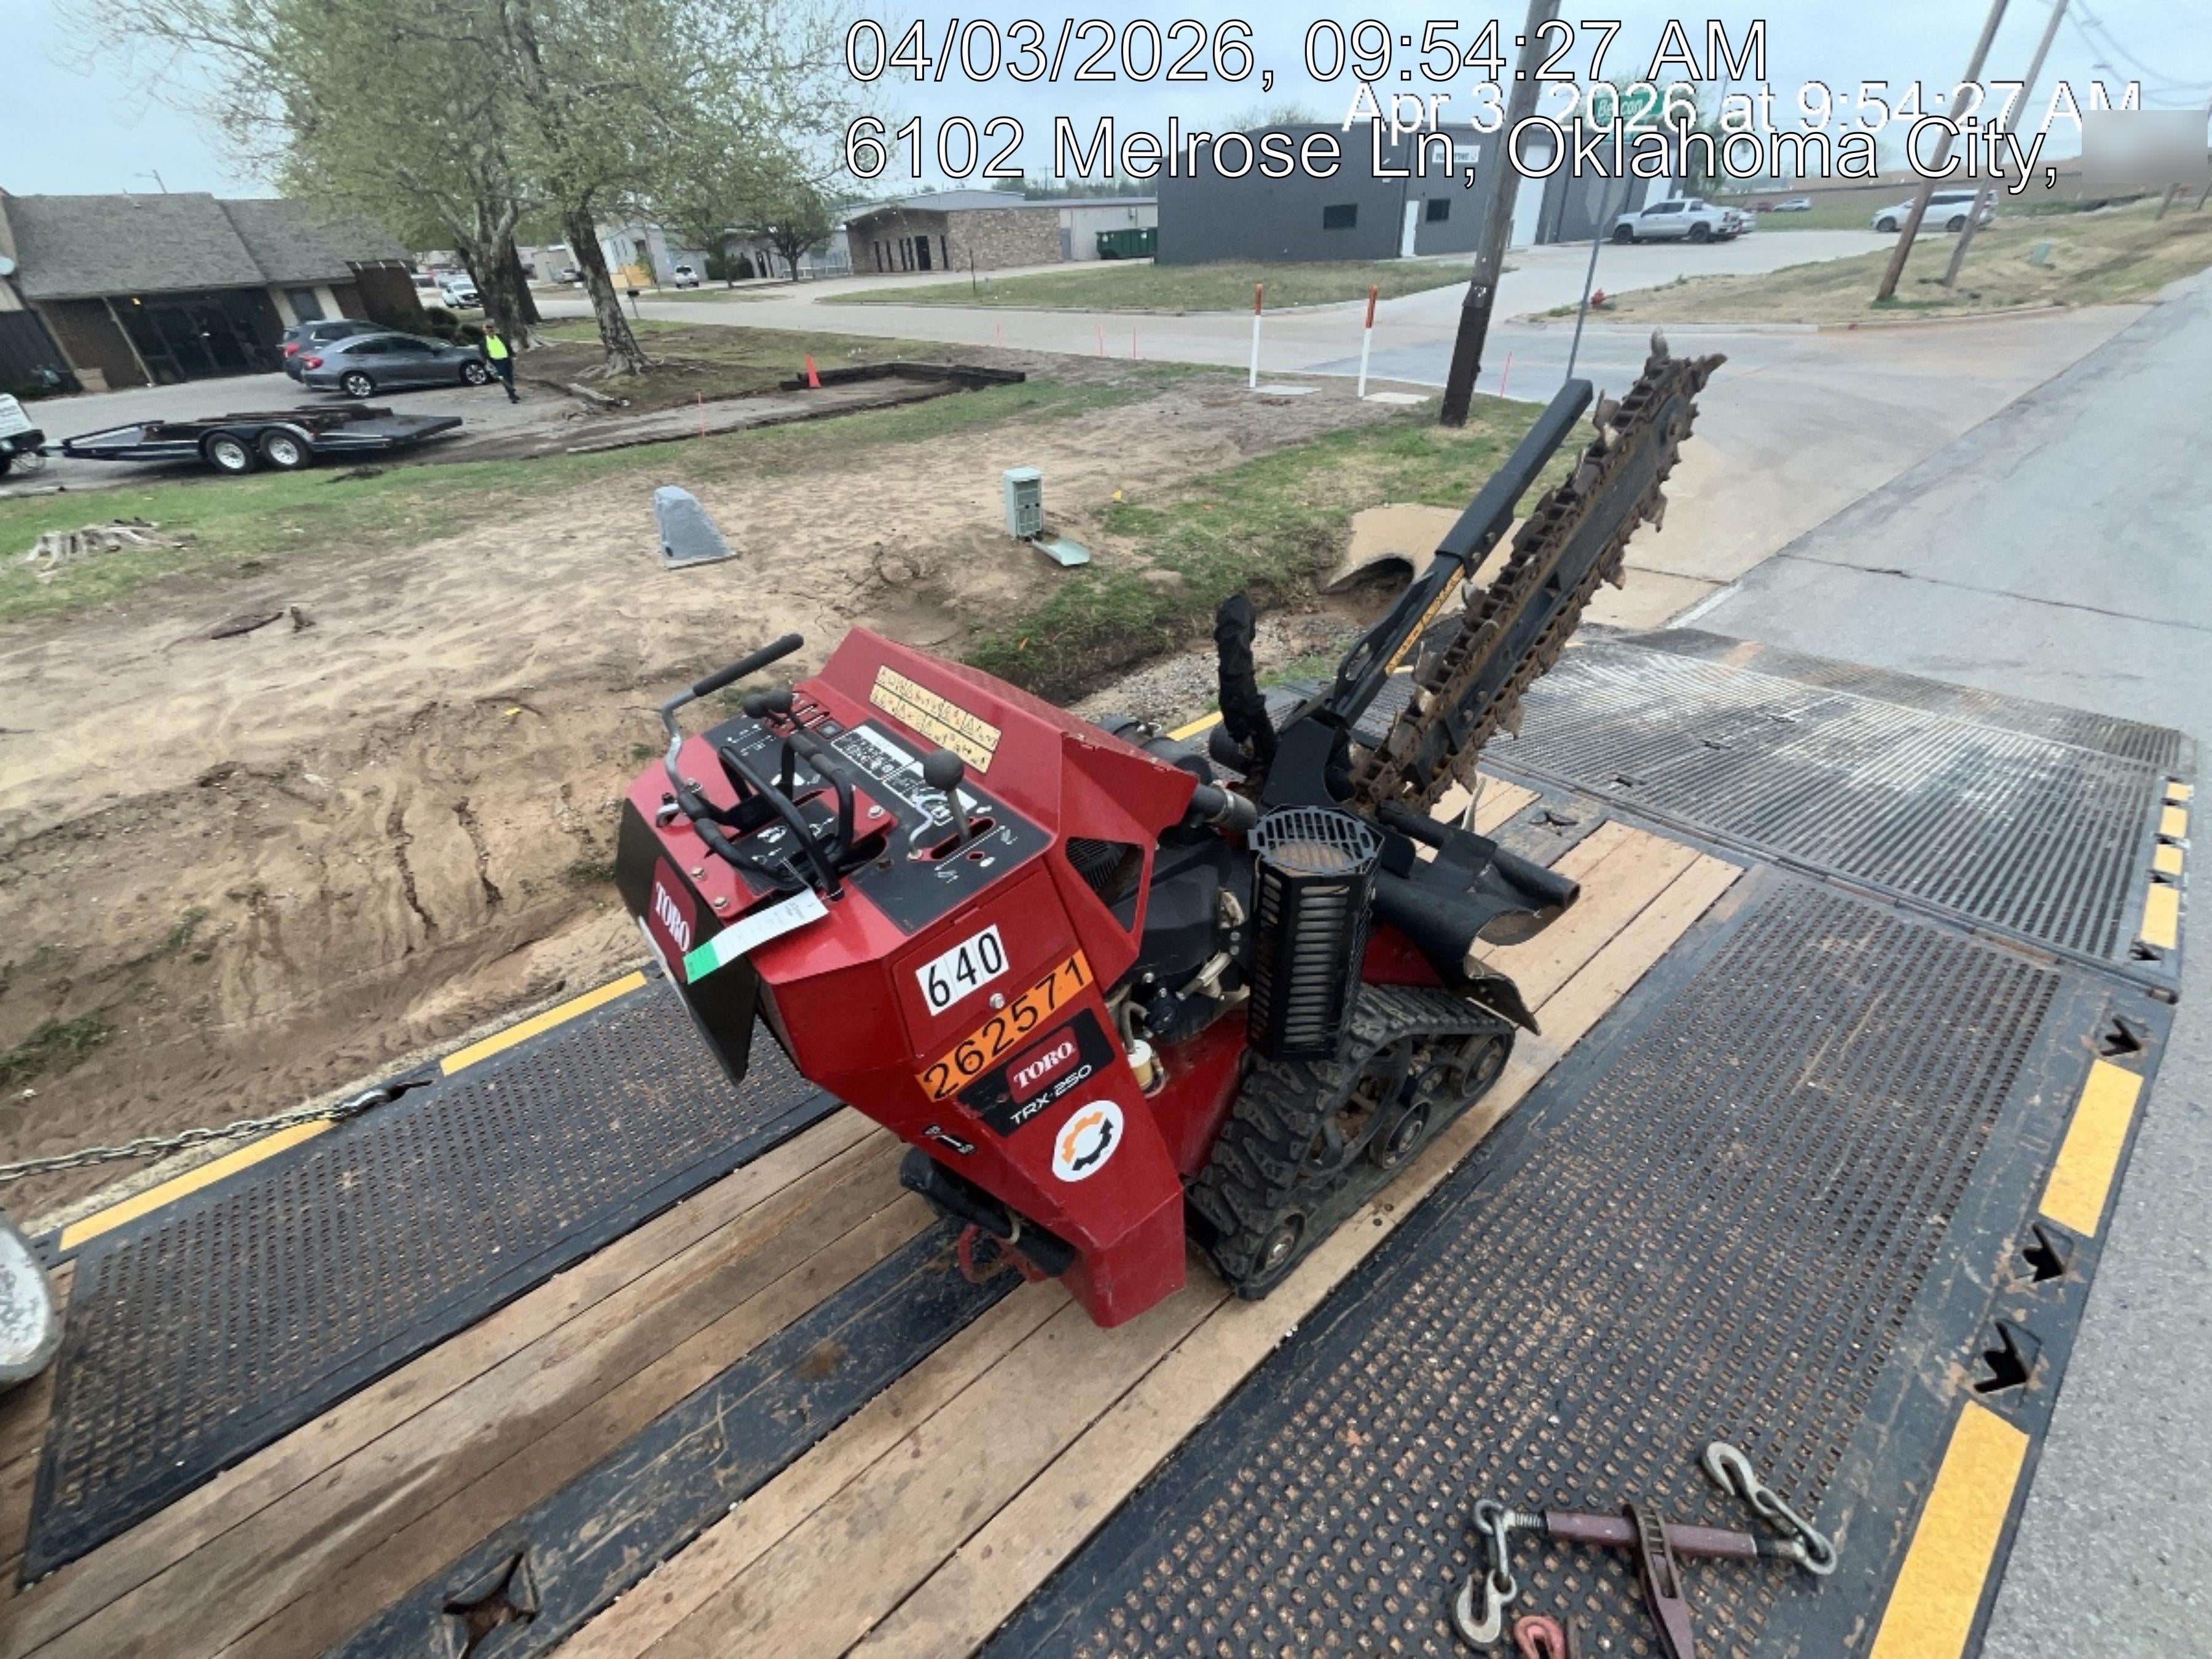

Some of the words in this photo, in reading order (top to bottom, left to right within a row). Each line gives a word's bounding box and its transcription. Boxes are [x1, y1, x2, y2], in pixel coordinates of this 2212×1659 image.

[1598, 98, 1643, 117] Becon
[655, 880, 691, 952] TORO
[927, 931, 1003, 1008] 640
[924, 956, 1084, 1100] 262571
[1013, 1040, 1075, 1088] TORO
